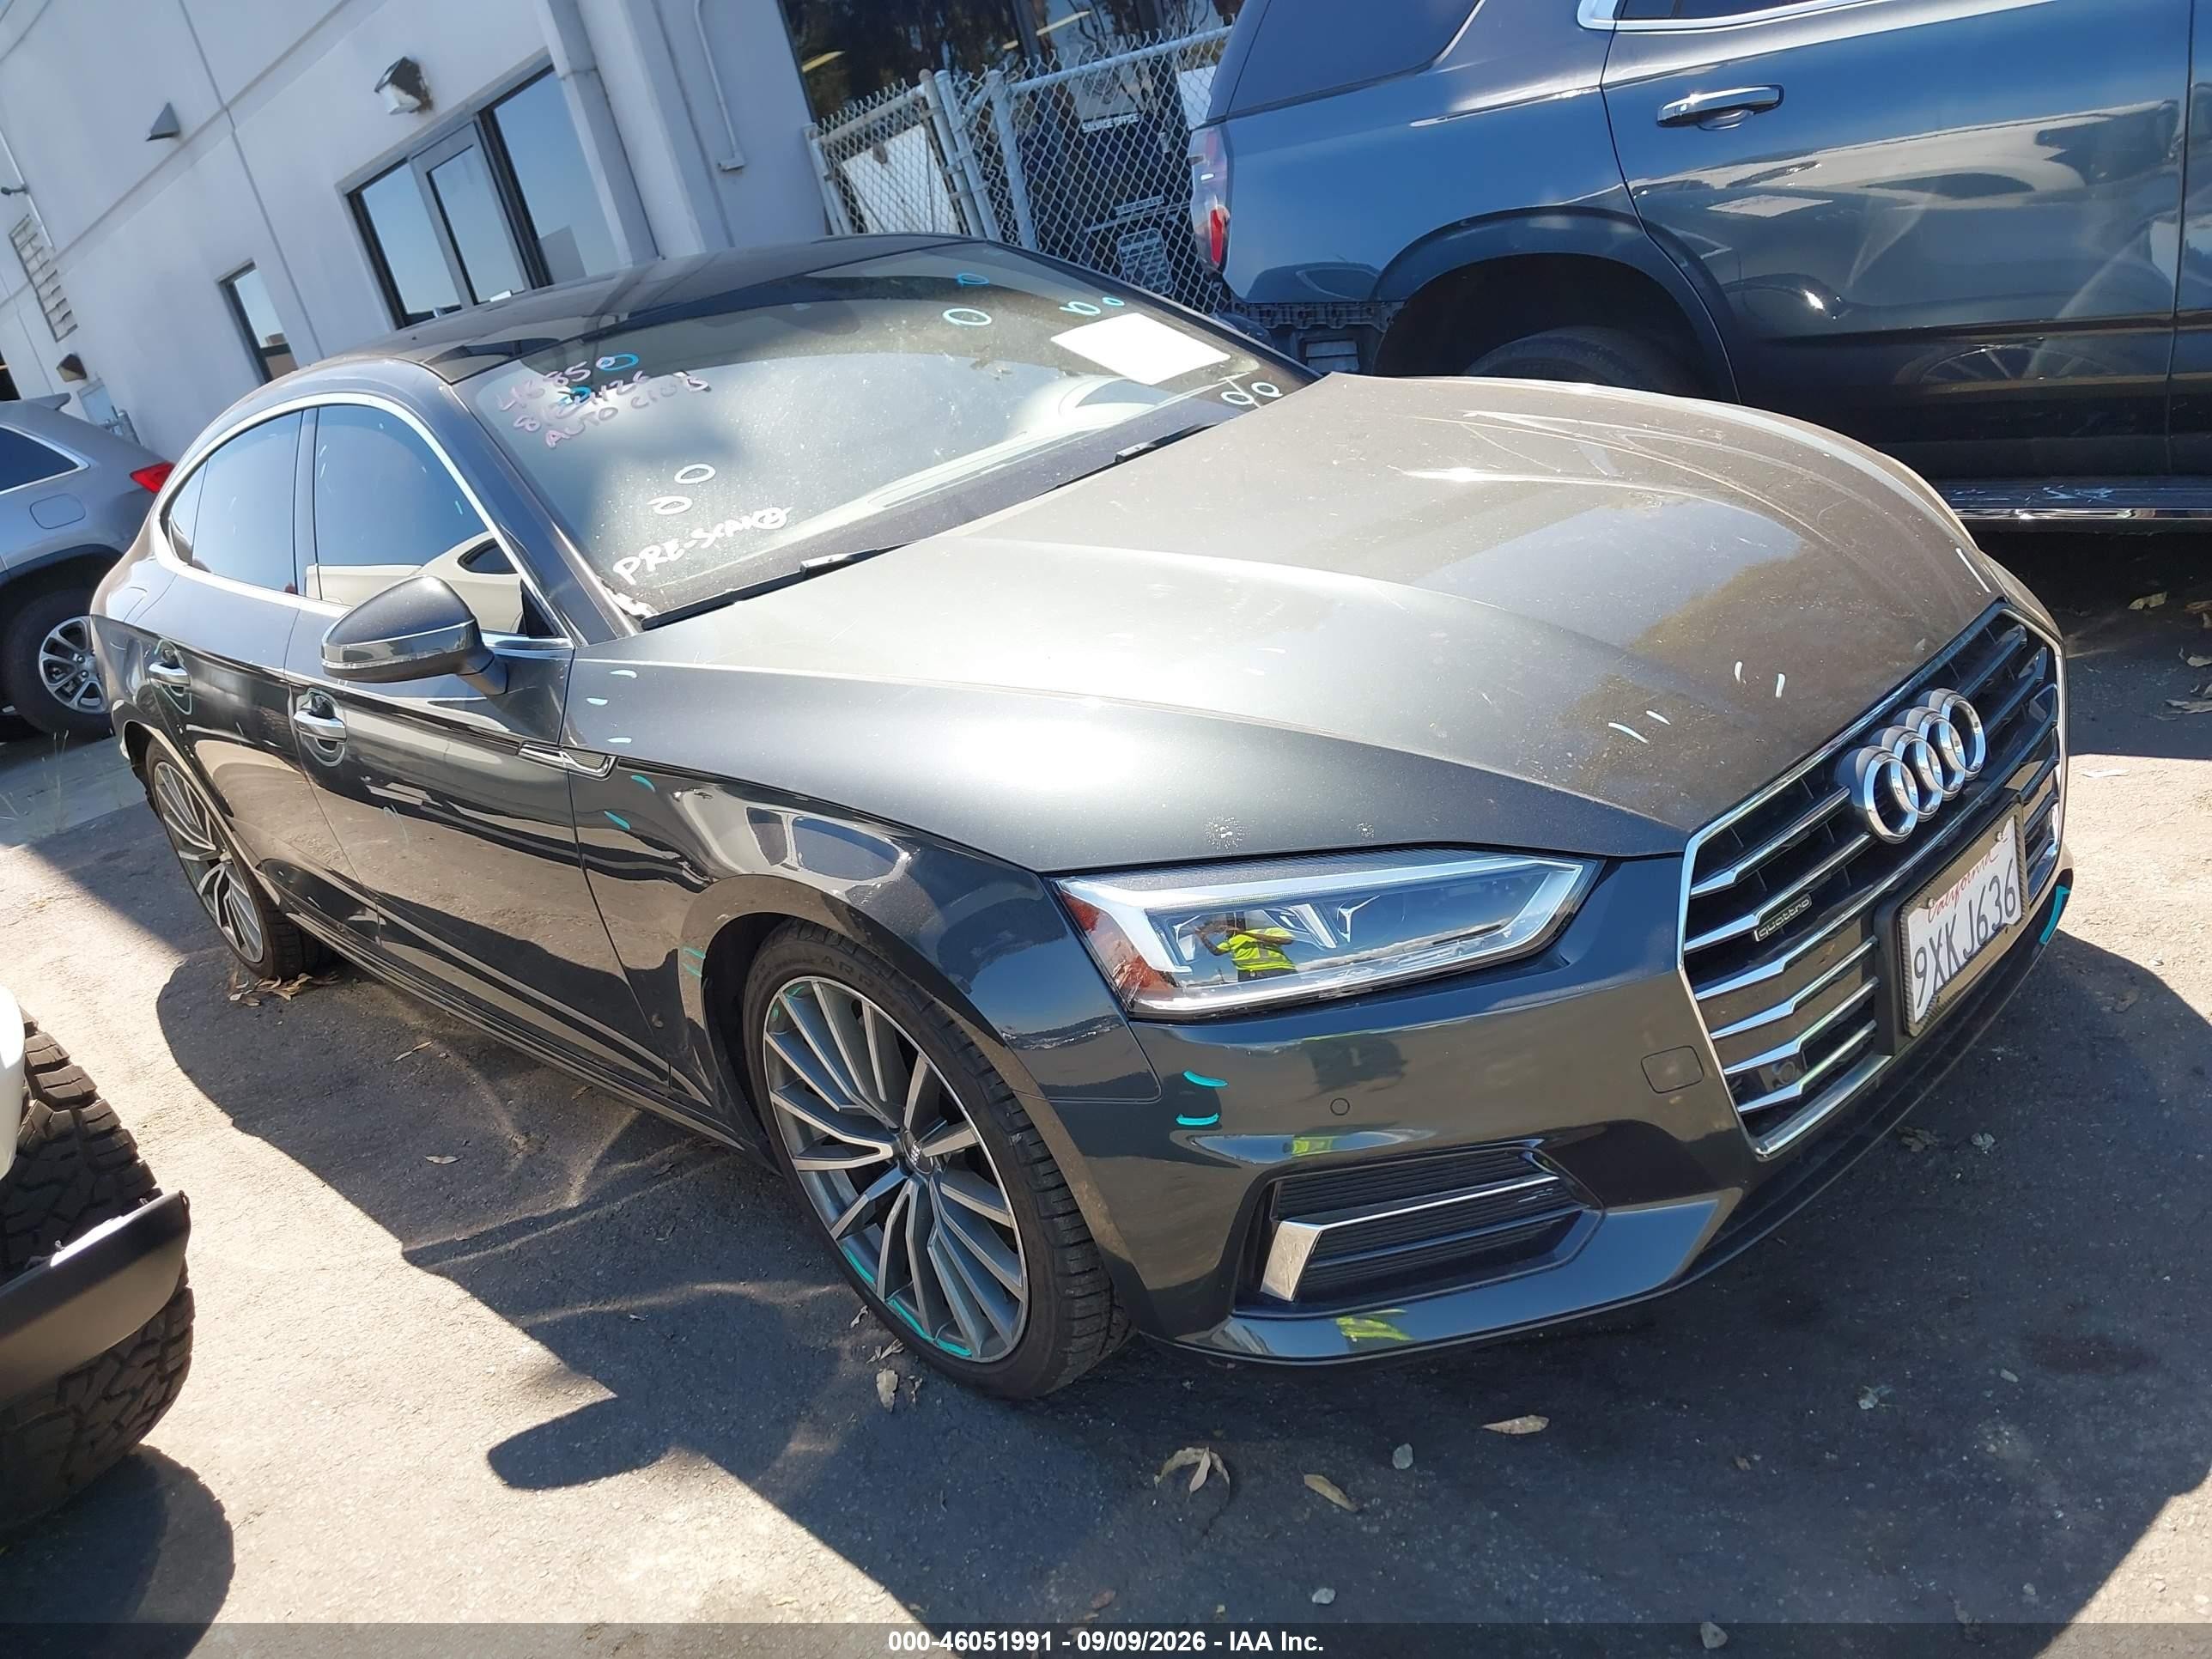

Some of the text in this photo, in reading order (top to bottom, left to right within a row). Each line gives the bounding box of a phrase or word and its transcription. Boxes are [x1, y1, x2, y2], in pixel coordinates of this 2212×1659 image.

[545, 406, 618, 448] AUTO
[1758, 899, 1810, 937] quattro
[1914, 858, 2016, 1009] 9XKJ636
